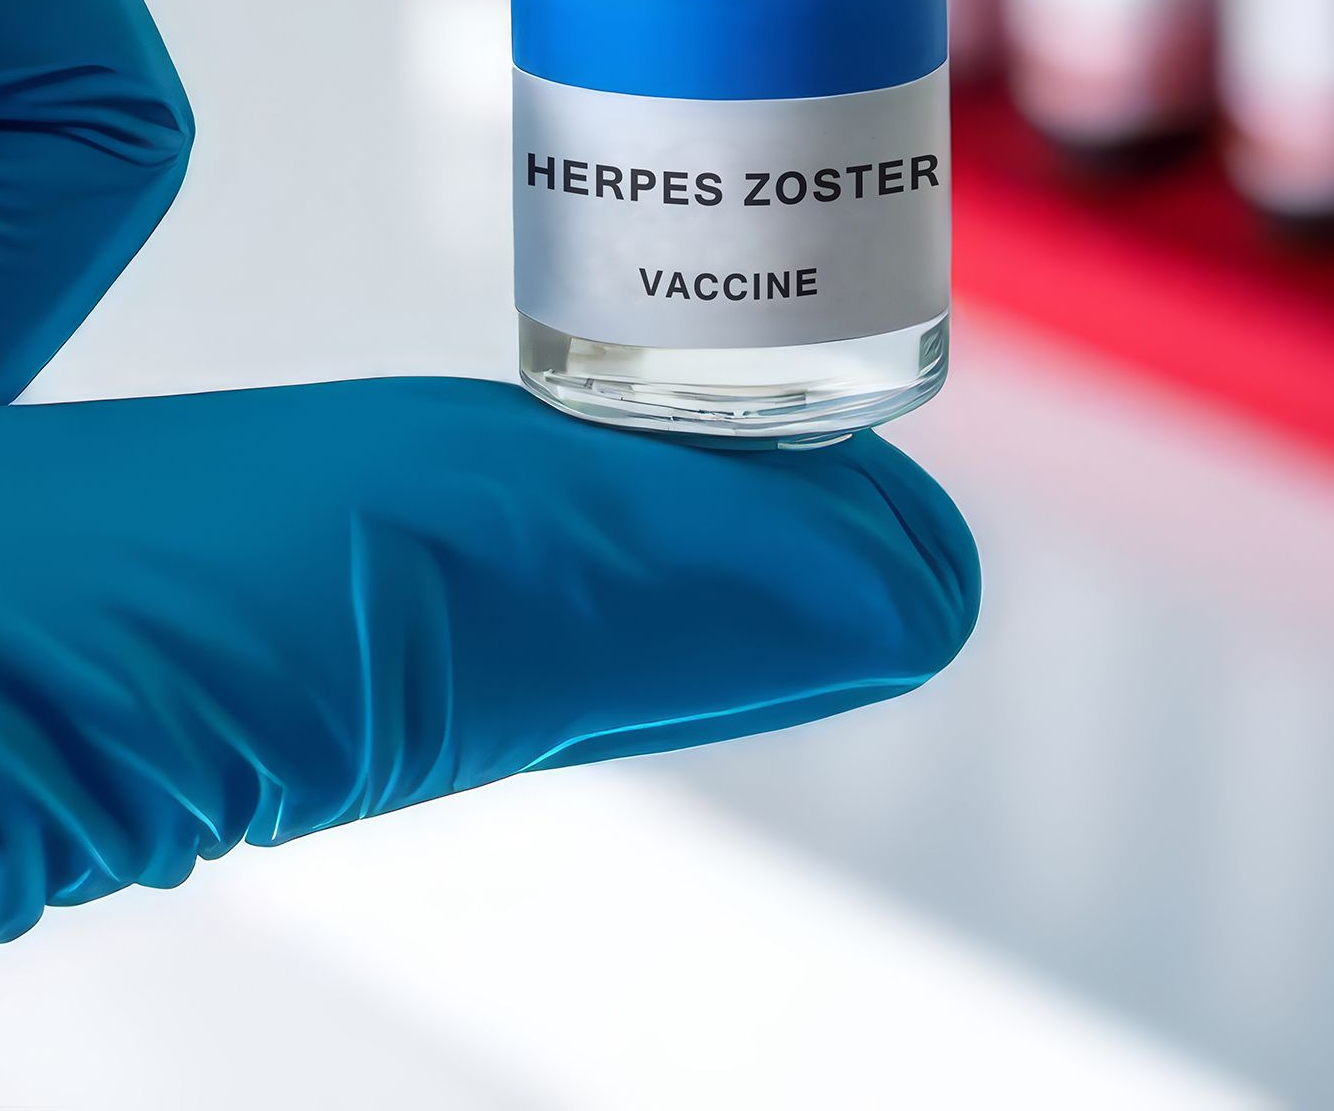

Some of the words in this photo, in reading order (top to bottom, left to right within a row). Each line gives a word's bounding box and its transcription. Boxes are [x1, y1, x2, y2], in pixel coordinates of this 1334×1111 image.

[527, 153, 723, 206] HERPES
[744, 154, 939, 206] ZOSTER
[639, 268, 818, 301] VACCINE
